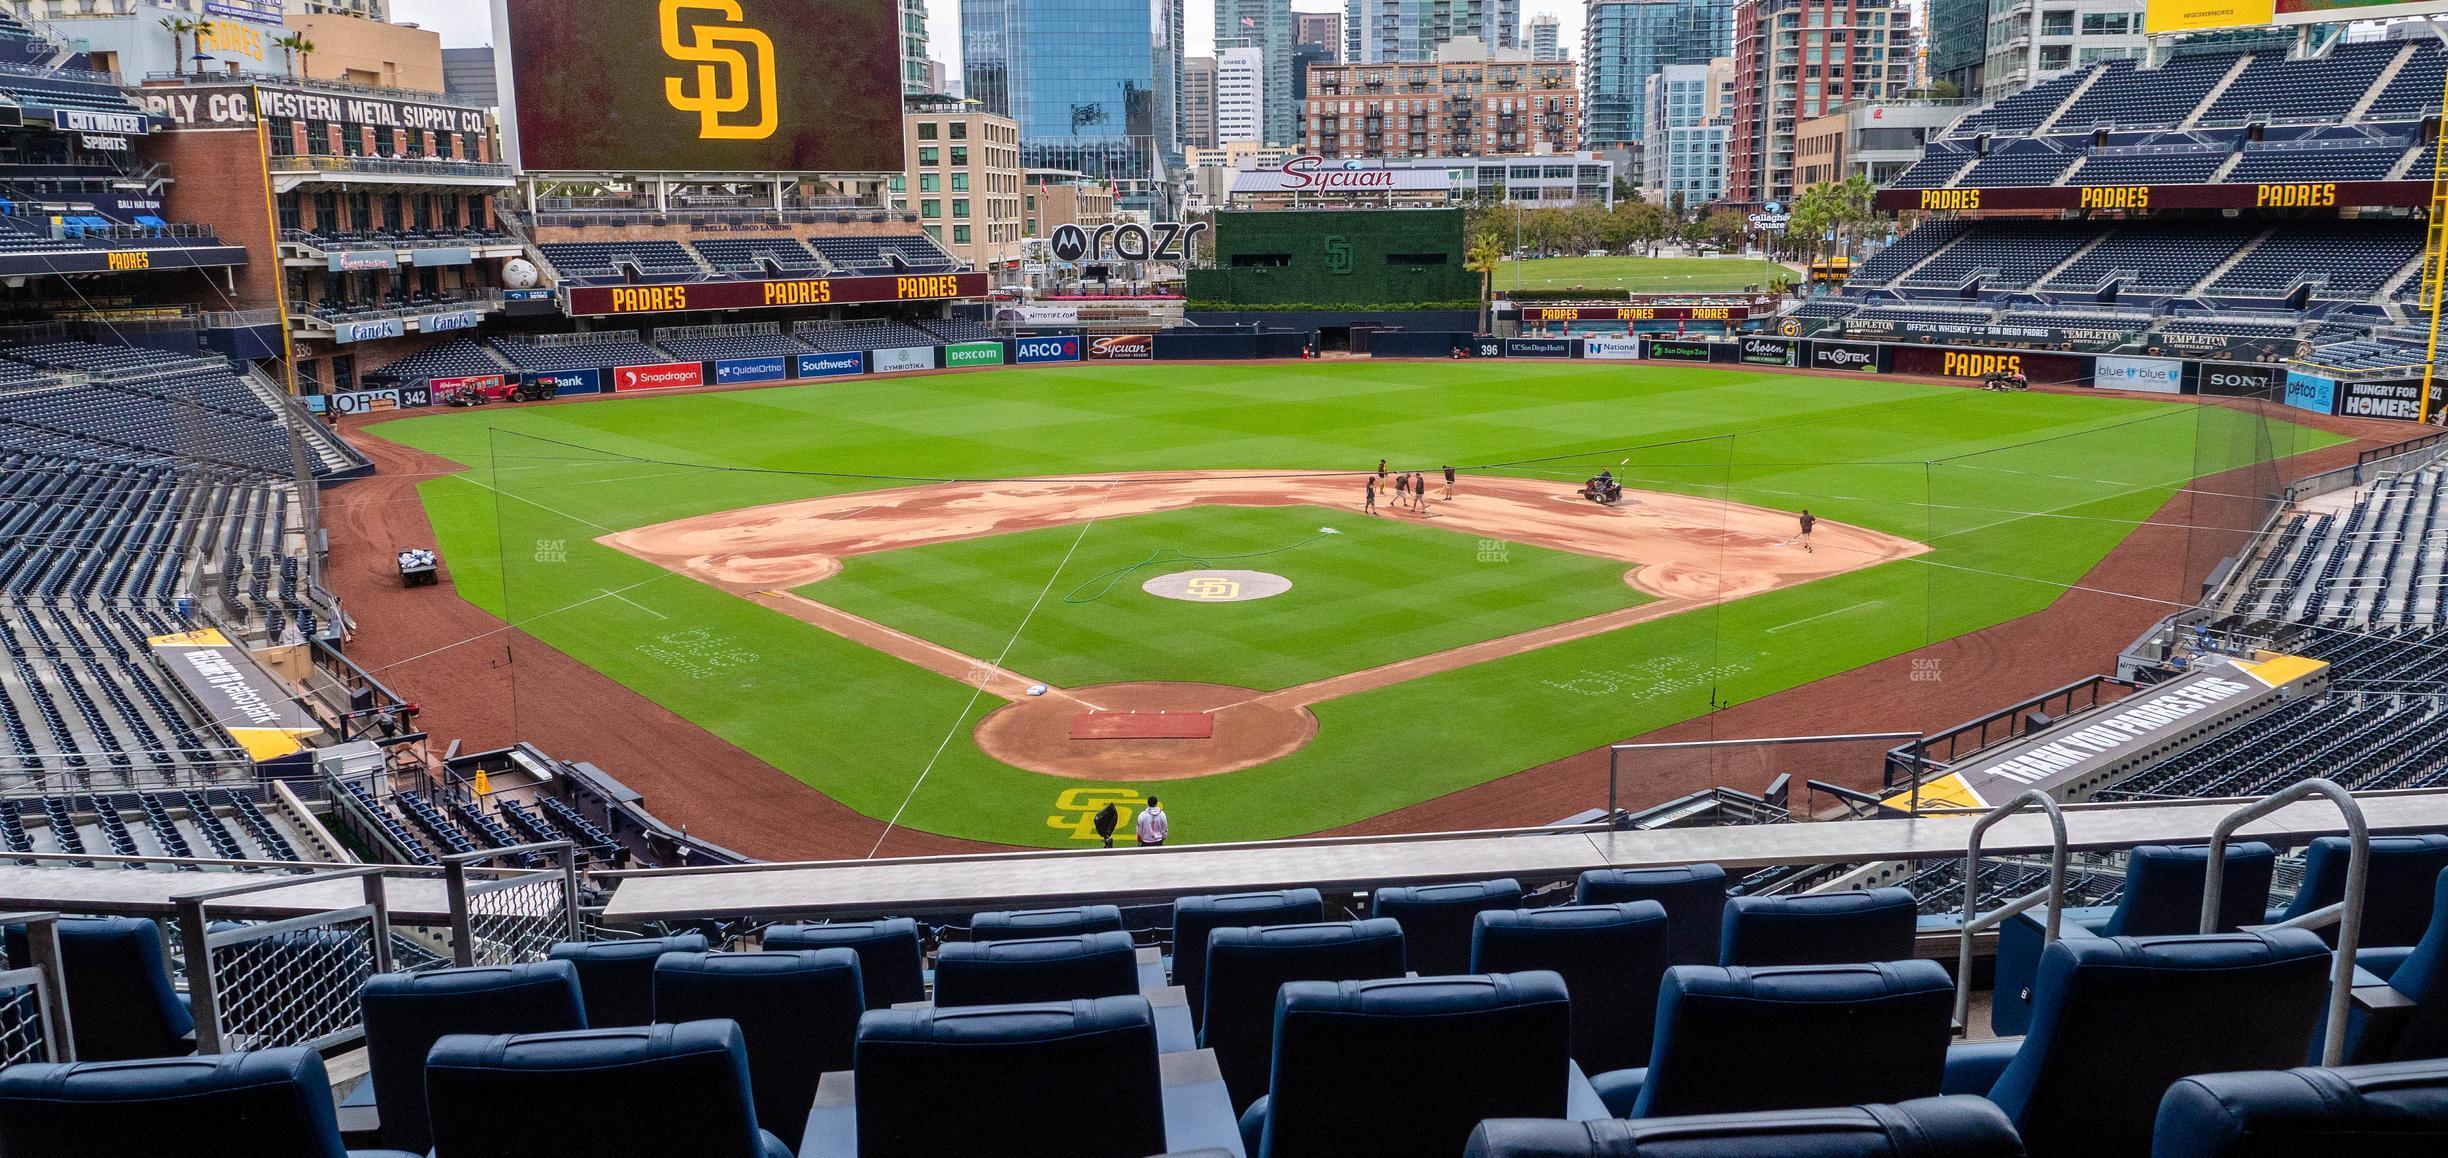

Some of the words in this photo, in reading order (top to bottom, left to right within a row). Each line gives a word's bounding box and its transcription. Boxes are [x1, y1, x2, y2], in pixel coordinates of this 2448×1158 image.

[659, 0, 778, 139] SD
[259, 90, 341, 121] WESTERN
[348, 100, 400, 126] METAL
[403, 106, 457, 131] SUPPLY
[462, 113, 485, 133] CO.
[67, 111, 140, 133] CUTWATER
[82, 134, 128, 151] SPIRITS
[1280, 155, 1395, 197] Sycuan
[1921, 189, 1980, 209] PADRES
[2081, 186, 2149, 208] PADRES
[2257, 183, 2336, 207] PADRES
[1754, 222, 1785, 230] Square
[1092, 222, 1208, 261] razr
[108, 251, 149, 270] PADRES
[764, 280, 831, 305] PADRES
[897, 275, 958, 298] PADRES
[612, 285, 686, 312] PADRES
[1541, 308, 1578, 320] PADRES
[1617, 308, 1654, 320] PADRES
[1692, 307, 1729, 319] PADRES
[432, 313, 469, 331] Canel's
[1845, 319, 1895, 331] TEMPLETON
[351, 321, 393, 340] Canel's
[1906, 323, 1937, 332] OFFICIAL
[1938, 324, 1970, 334] WHISKEY
[1987, 327, 2000, 335] SAN
[2002, 327, 2021, 336] DIEGO
[2022, 328, 2049, 337] PADRES
[2061, 329, 2122, 342] TEMPLETON
[1092, 337, 1147, 358] Sycuan
[1532, 344, 1547, 352] Diego
[1603, 343, 1635, 351] National
[1745, 340, 1784, 354] Chosen
[2162, 334, 2228, 347] TEMPLETON
[952, 349, 997, 360] Dexcom
[1018, 343, 1062, 357] ARCO
[1481, 344, 1498, 356] 396
[1676, 348, 1694, 356] Diego
[1694, 348, 1707, 356] Zoo
[1818, 348, 1871, 364] EVOTEK
[732, 364, 782, 376] QuidelOrtho
[802, 358, 852, 371] Southwest
[883, 363, 924, 371] CYMBIOTIKA
[1944, 351, 2021, 378] PADRES
[2098, 365, 2124, 377] blue
[641, 371, 697, 383] Snapdragon
[2139, 367, 2166, 379] blue
[2210, 373, 2268, 387] SONY
[554, 375, 583, 387] bank
[2287, 380, 2316, 399] petco
[2352, 383, 2395, 396] HUNGRY
[2396, 385, 2417, 398] FOR
[404, 390, 427, 405] 342
[2346, 396, 2420, 418] HOMERS
[232, 702, 282, 724] park
[1983, 742, 2094, 784] THANK
[2058, 724, 2133, 752] YOU
[2100, 695, 2207, 736] PADRES
[2172, 676, 2250, 704] FANS
